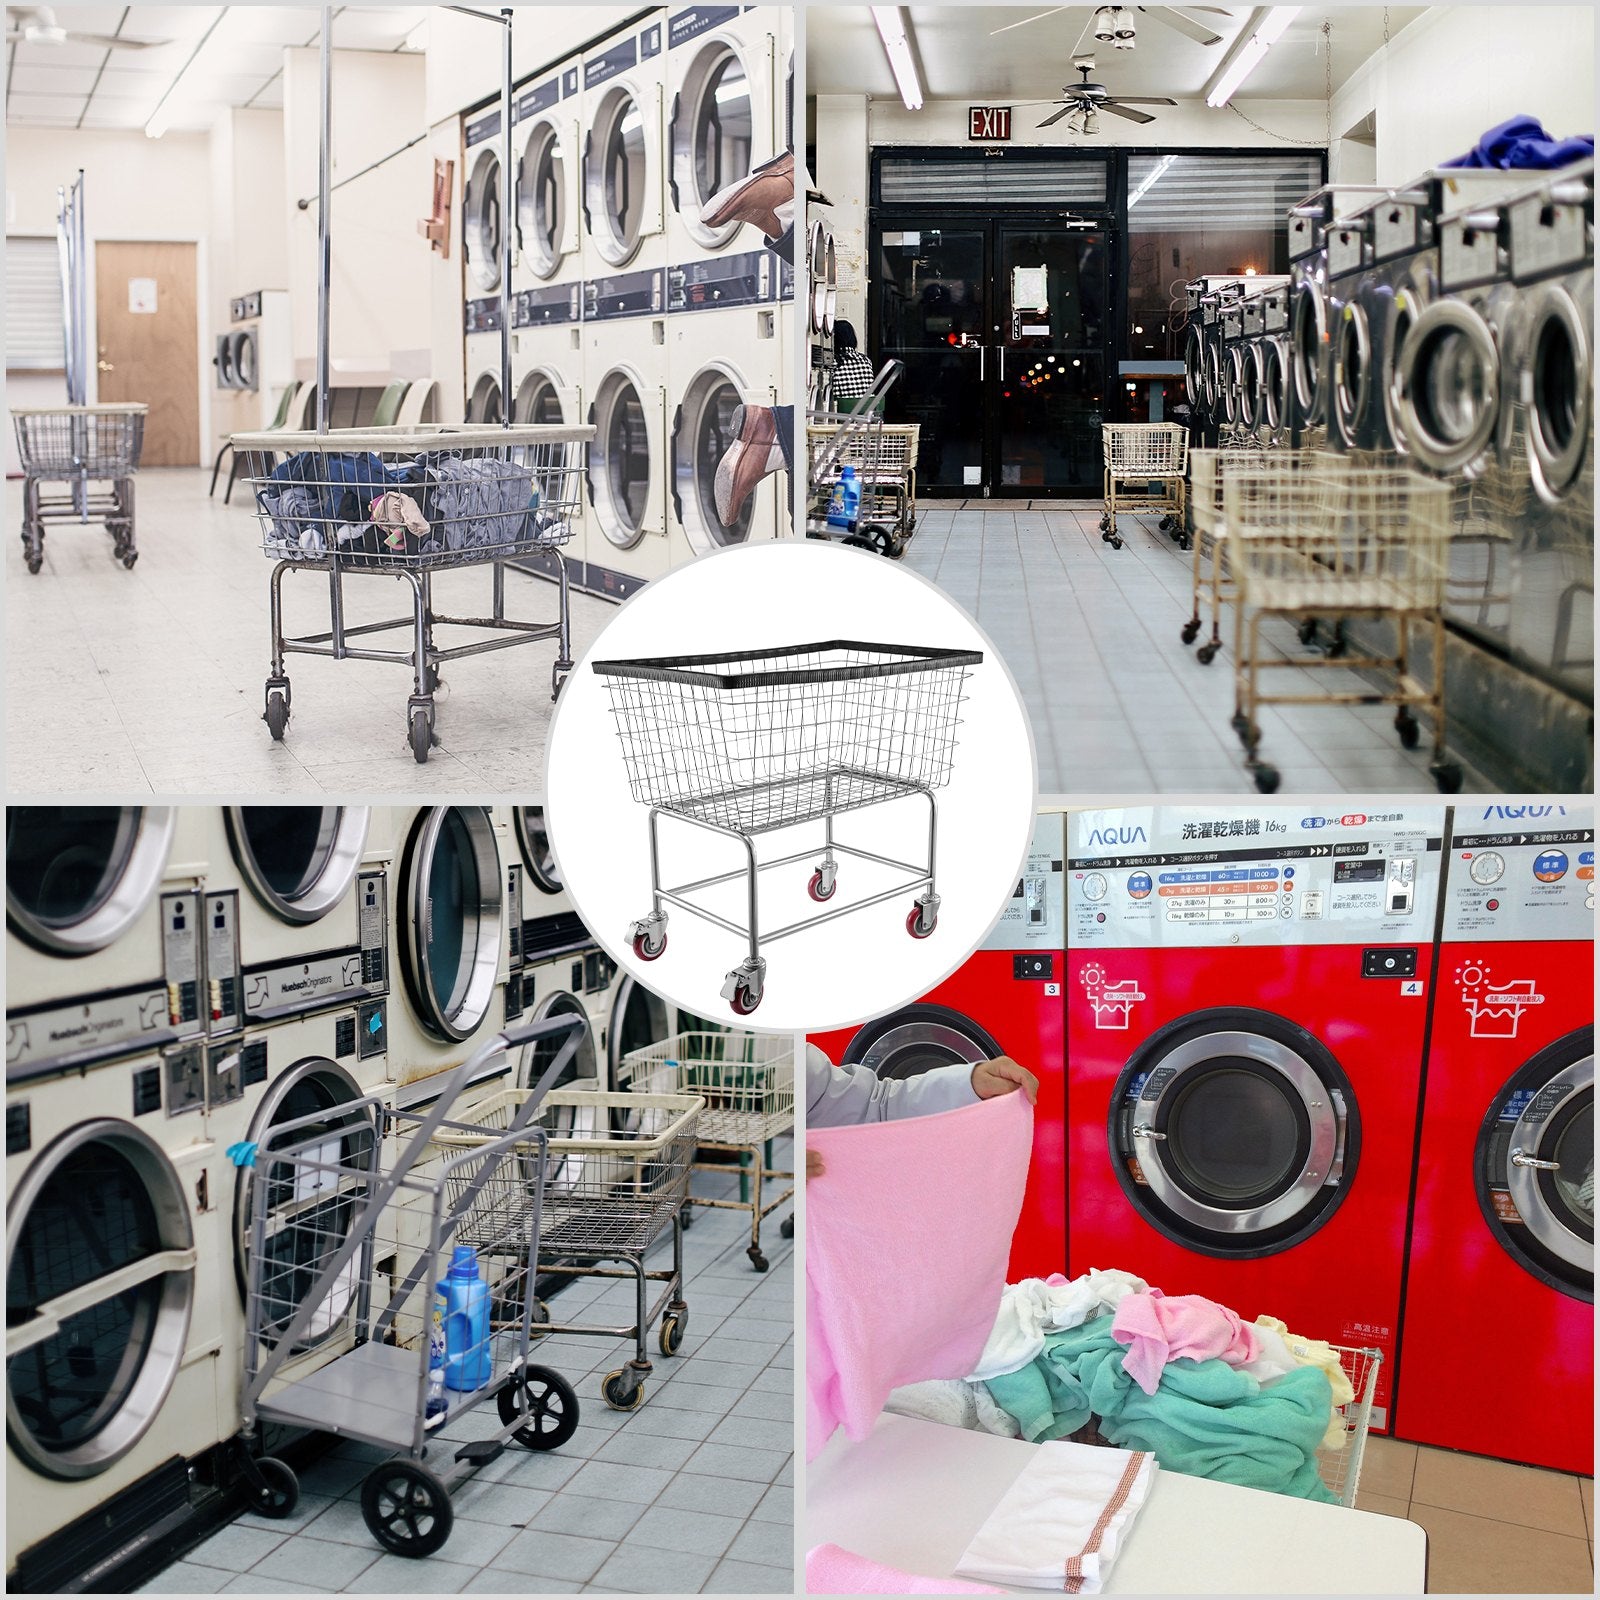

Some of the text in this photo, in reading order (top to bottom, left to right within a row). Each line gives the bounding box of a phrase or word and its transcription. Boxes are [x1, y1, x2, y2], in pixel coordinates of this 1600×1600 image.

[971, 109, 1009, 137] EXIT
[1088, 826, 1147, 847] AQUA
[1181, 818, 1287, 841] 洗濯乾燥機 16kg
[1532, 833, 1579, 842] 洗濯物を入れる
[1344, 861, 1363, 870] 営業中
[280, 974, 332, 994] HuebschOriginators
[1048, 985, 1056, 995] 3
[1406, 983, 1417, 994] 4
[1353, 1322, 1389, 1336] 高温注意
